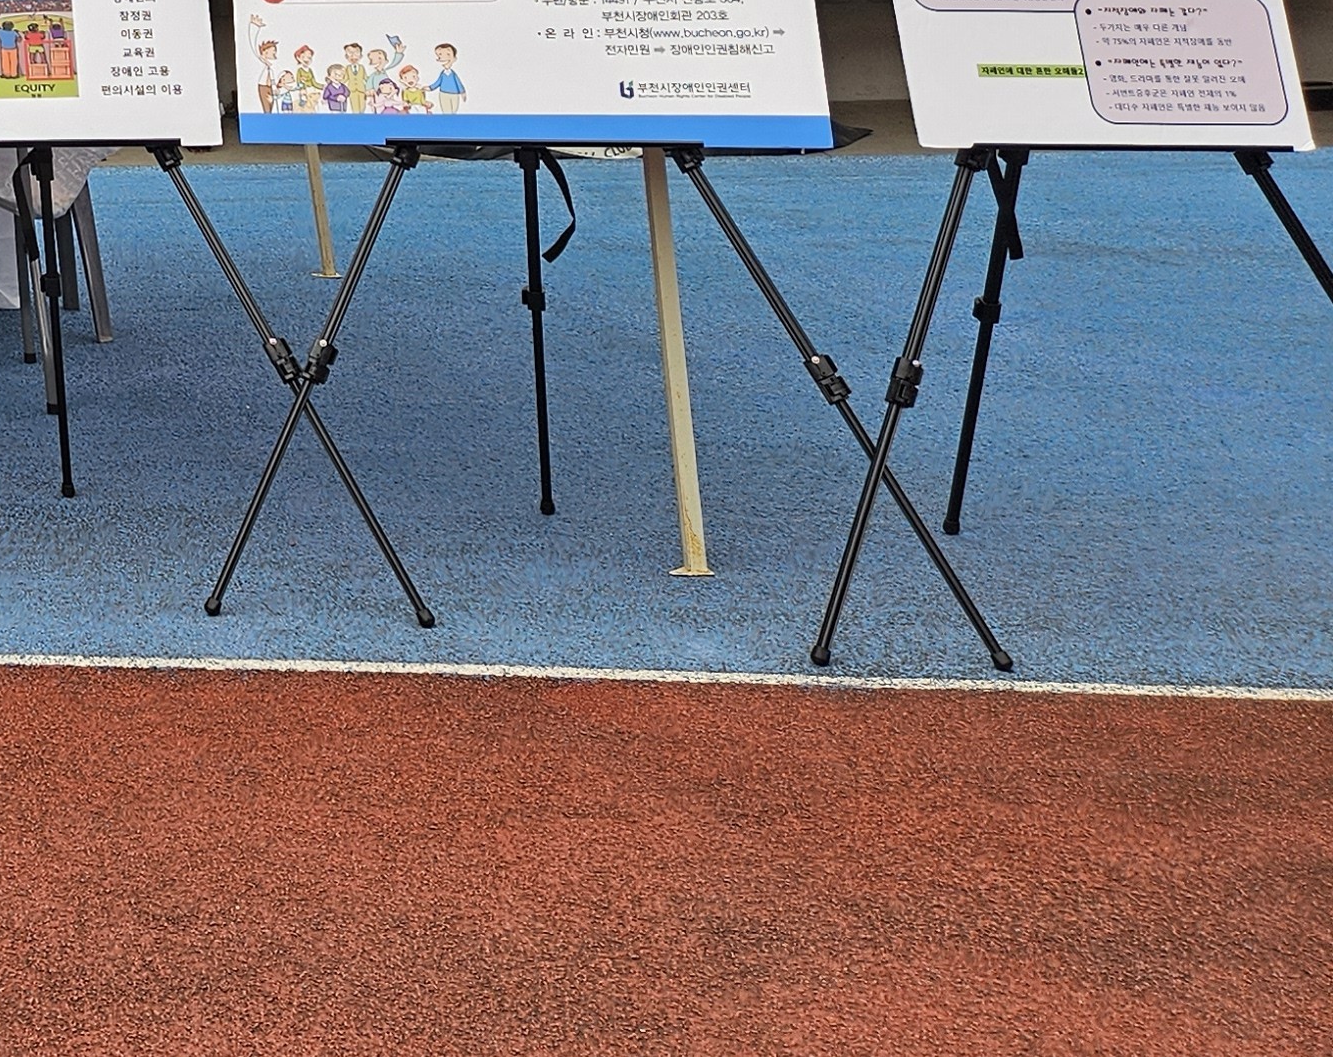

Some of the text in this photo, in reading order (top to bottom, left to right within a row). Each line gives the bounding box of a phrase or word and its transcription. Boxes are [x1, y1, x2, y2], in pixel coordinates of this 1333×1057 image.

[601, 10, 729, 22] 부천시장애인회관 203호
[121, 28, 153, 40] 이동권
[123, 47, 155, 58] 교육권
[605, 43, 775, 56] 전자민원 장애인인권침해신고
[110, 66, 170, 77] 장애인 고용
[14, 83, 55, 94] EQUITY
[101, 84, 183, 96] 편의시설의 이용
[637, 81, 751, 94] 부천시장애인인권센터
